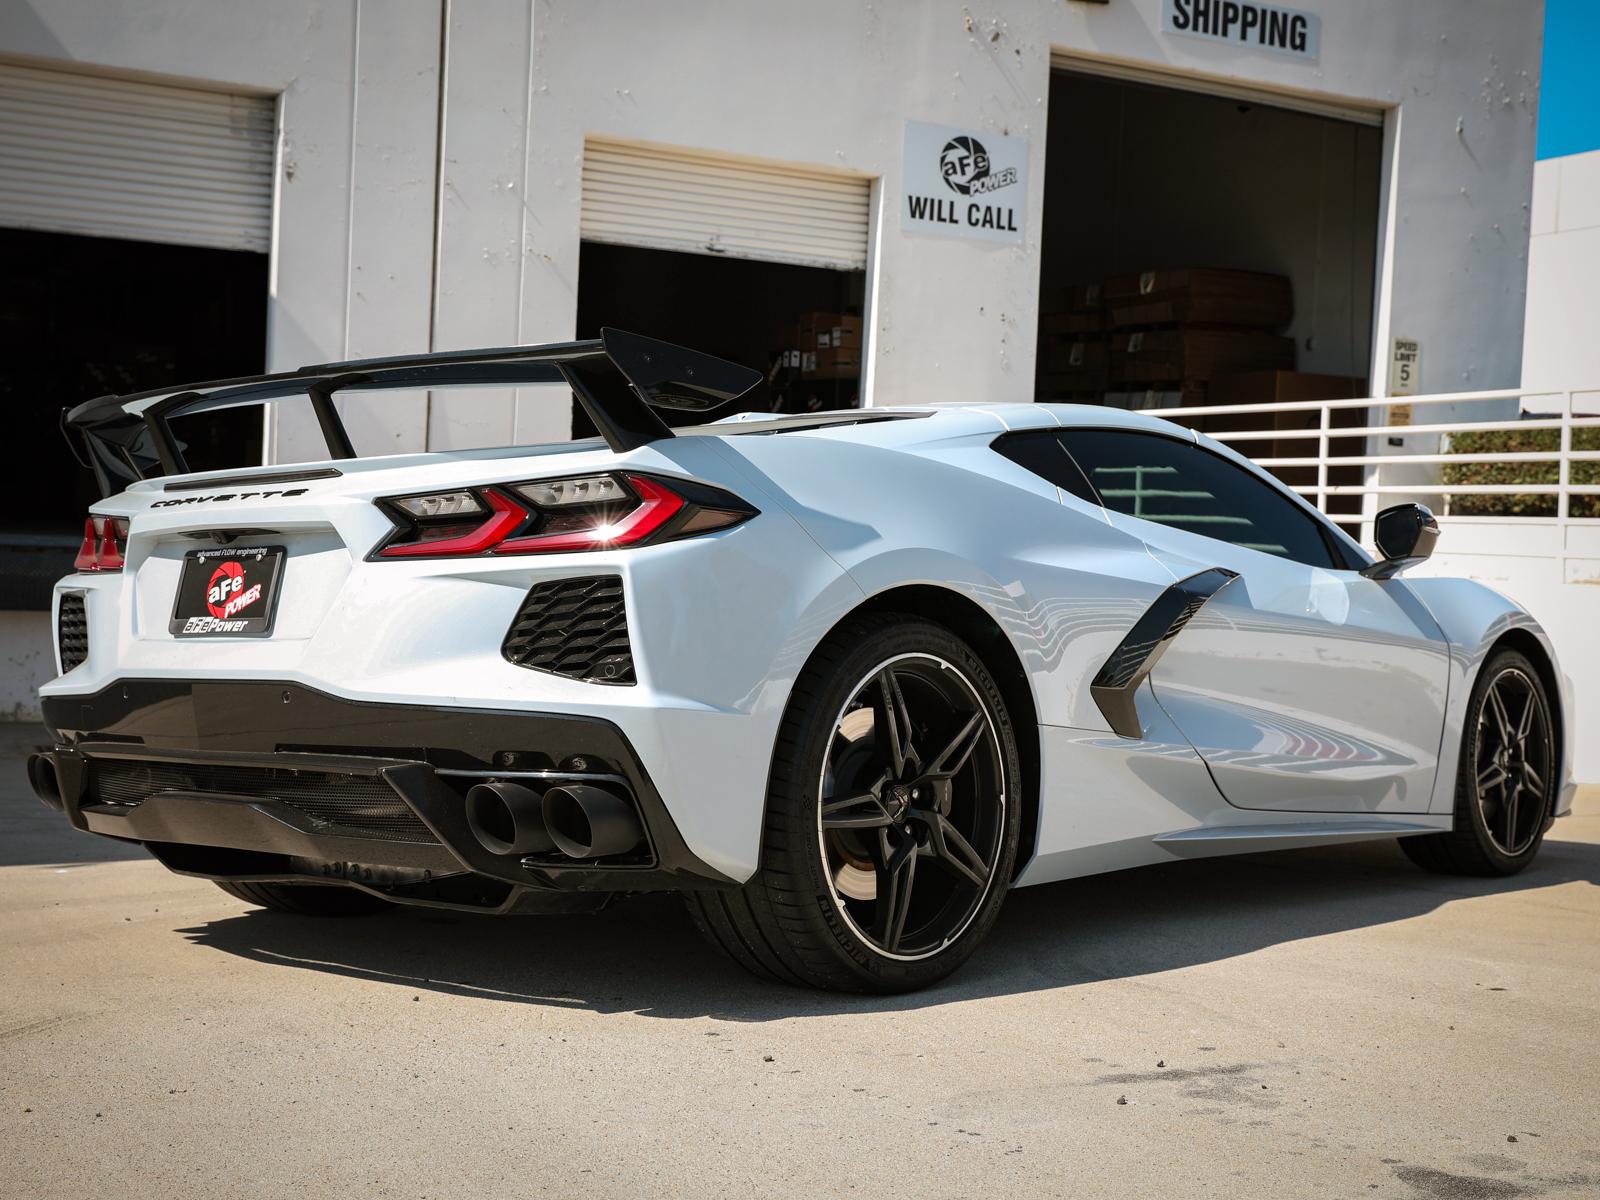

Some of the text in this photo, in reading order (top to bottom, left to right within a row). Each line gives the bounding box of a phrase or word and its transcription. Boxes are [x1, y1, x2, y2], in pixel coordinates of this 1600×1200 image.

[1172, 0, 1307, 52] SHIPPING
[943, 154, 988, 177] aFe
[969, 167, 1018, 197] POWER
[908, 195, 1018, 232] WILL CALL
[1394, 352, 1417, 363] LIMIT
[1395, 341, 1418, 352] SPEED
[1400, 364, 1410, 381] 5
[150, 488, 309, 509] CORVETTE
[197, 547, 268, 558] advanced FLOW engineering
[208, 575, 243, 604] aFe
[224, 584, 262, 618] POWER
[968, 657, 1010, 724] MICHELIN
[818, 897, 873, 968] MICHELIN
